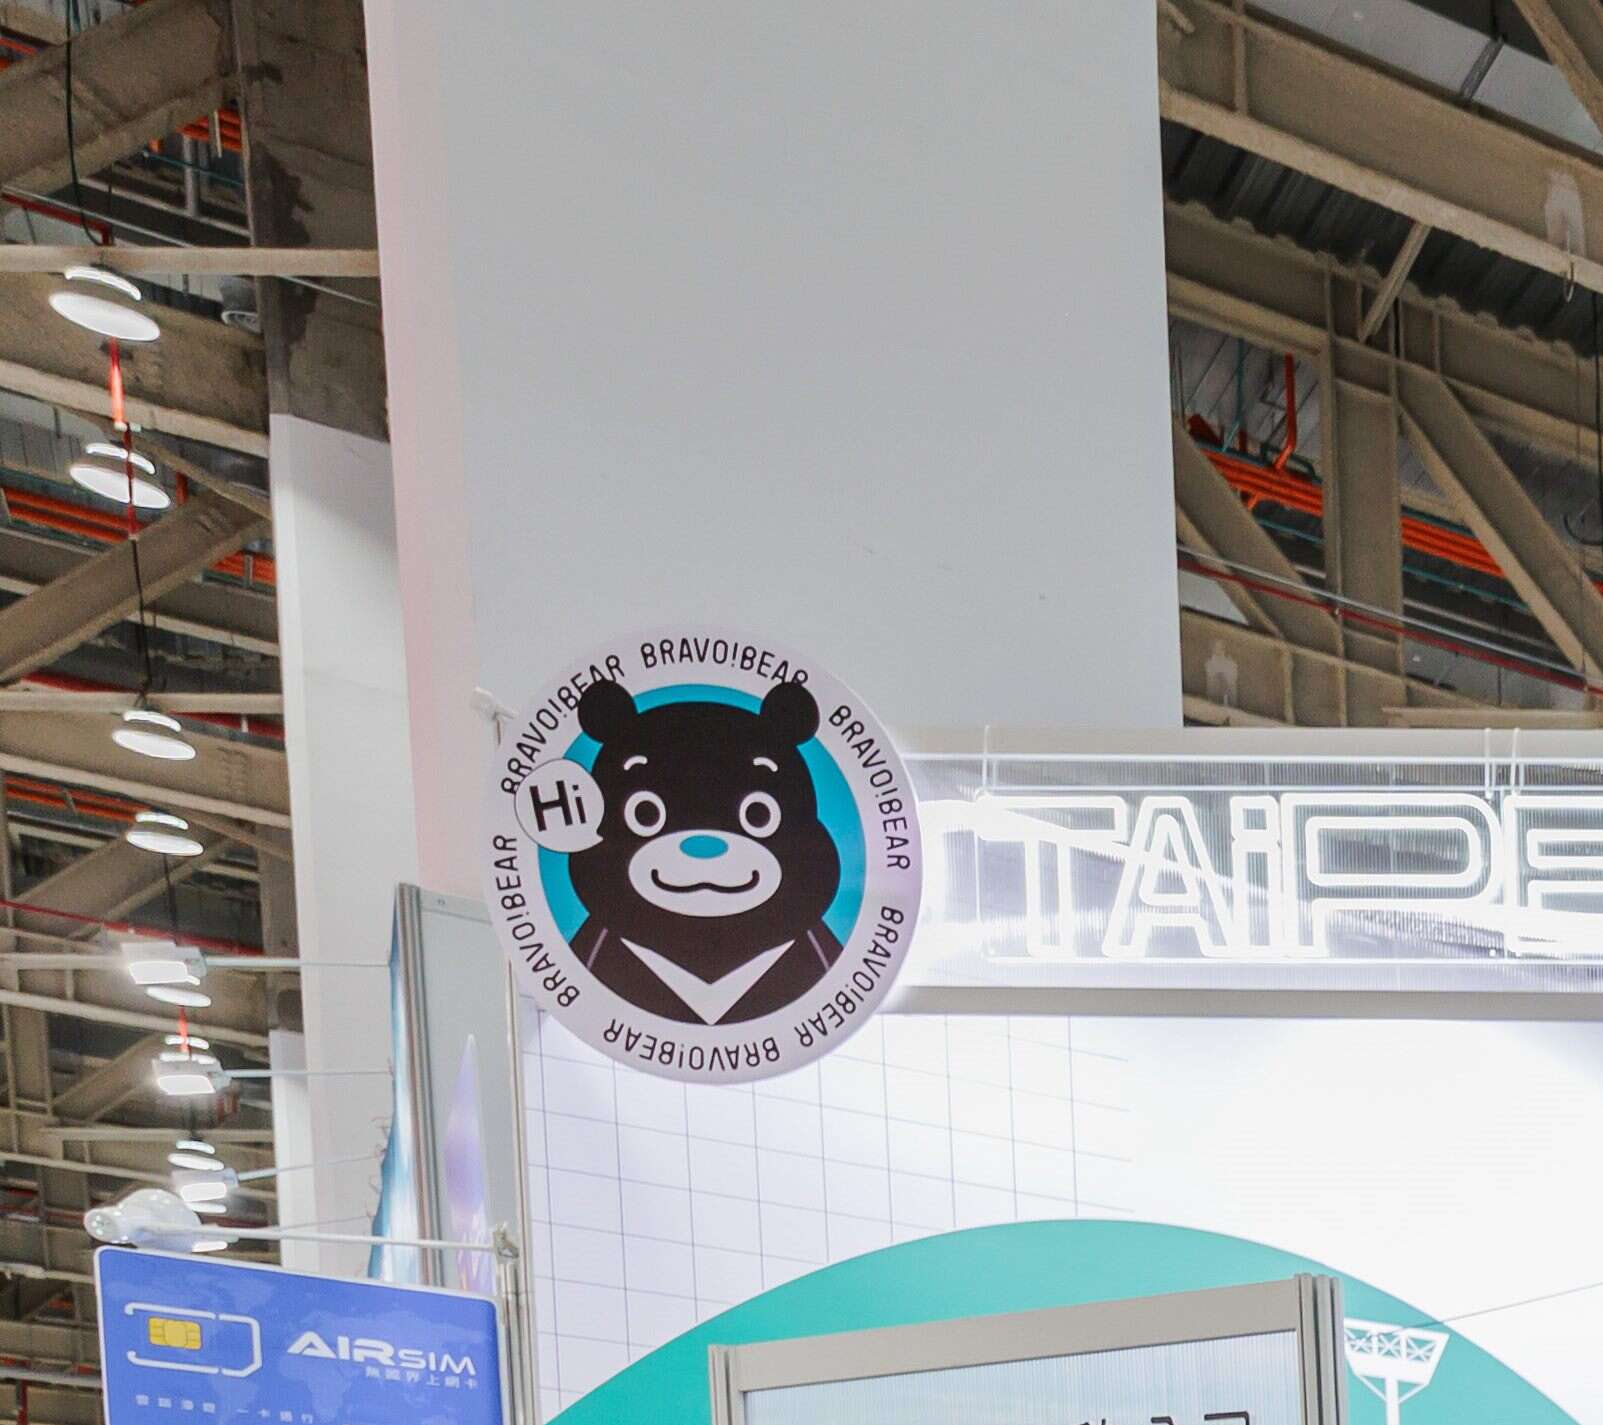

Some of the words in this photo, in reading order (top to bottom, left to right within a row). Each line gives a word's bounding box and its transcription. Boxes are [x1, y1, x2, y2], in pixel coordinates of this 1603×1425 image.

[640, 637, 810, 689] BRAVO!BEAR
[529, 780, 588, 832] Hi
[829, 705, 912, 871] BRAVO!BEAR
[493, 834, 581, 1007] BRAVO!BEAR
[794, 904, 905, 1047] BRAVO!BEAR
[602, 1018, 781, 1072] BRAVO!BEAR
[287, 1330, 477, 1377] AIRSIM
